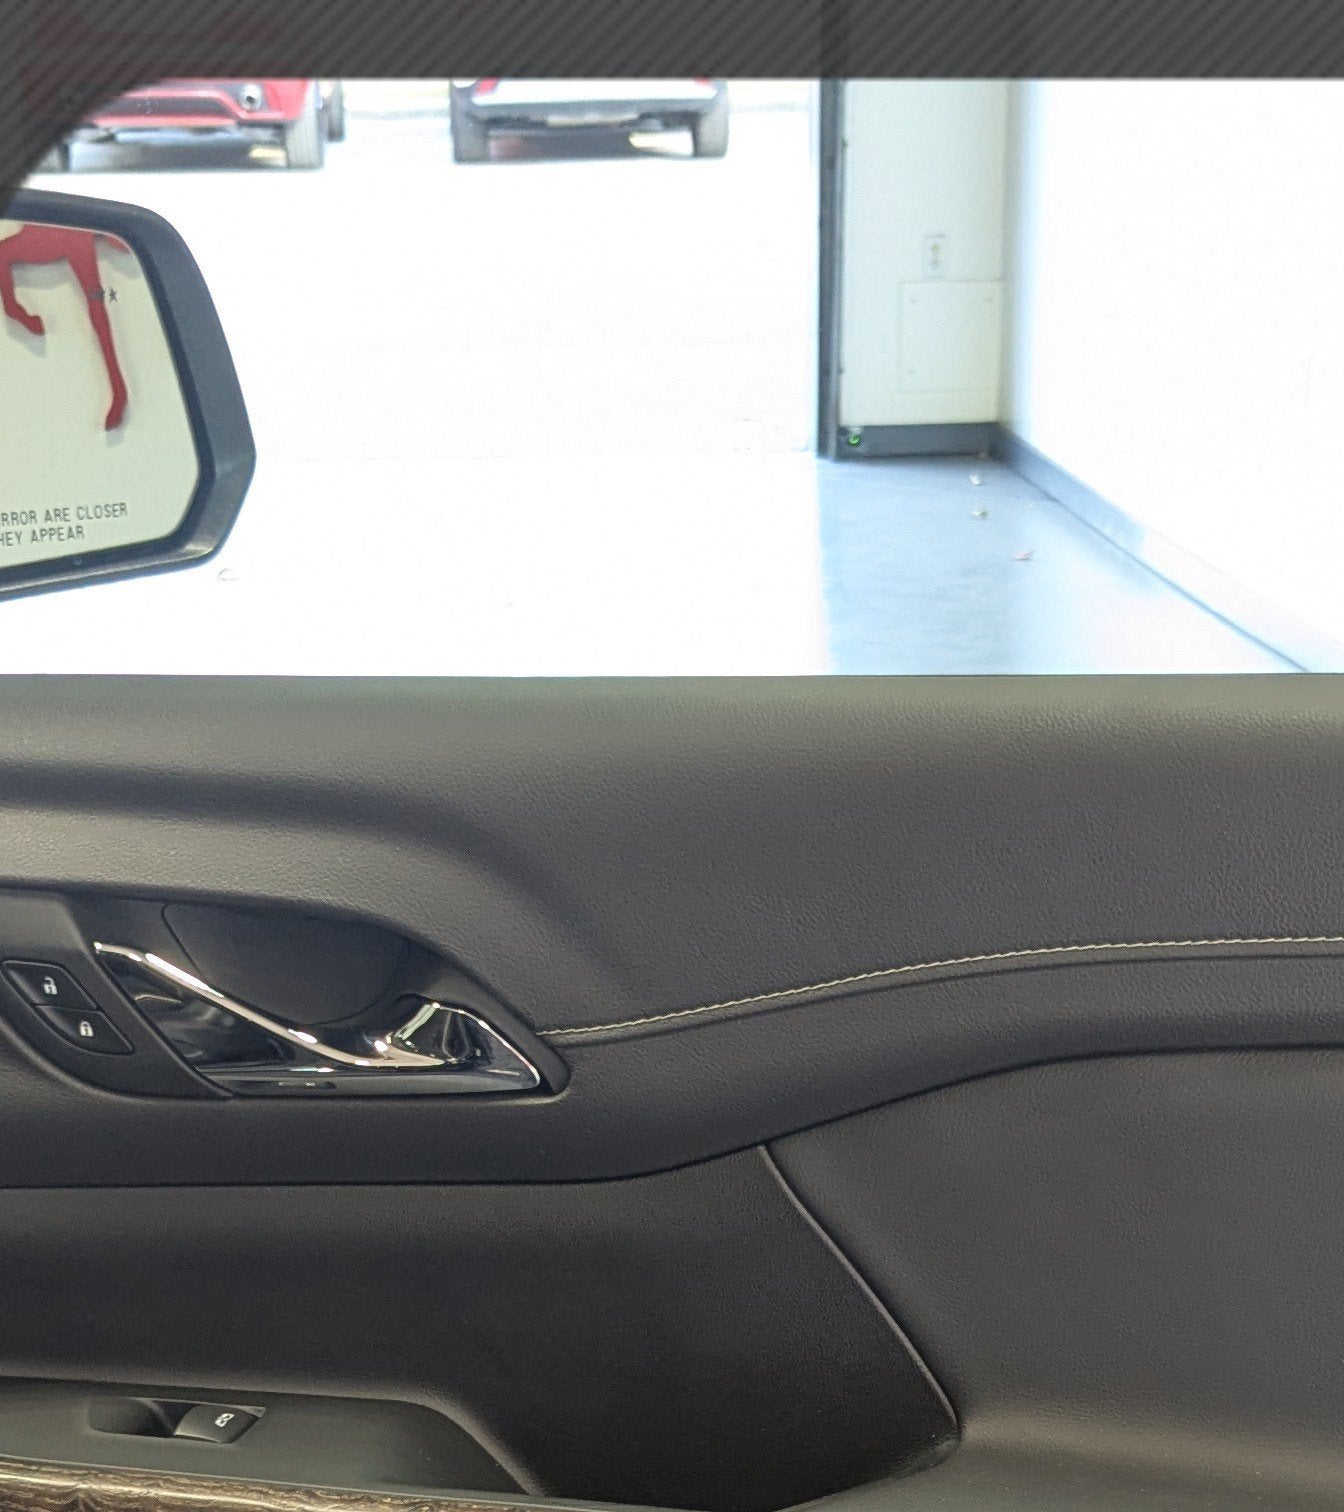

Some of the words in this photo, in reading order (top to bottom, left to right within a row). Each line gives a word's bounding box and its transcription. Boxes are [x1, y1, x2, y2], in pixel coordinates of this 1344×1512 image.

[44, 507, 70, 523] ARE
[76, 502, 129, 521] CLOSER
[31, 526, 85, 543] APPEAR
